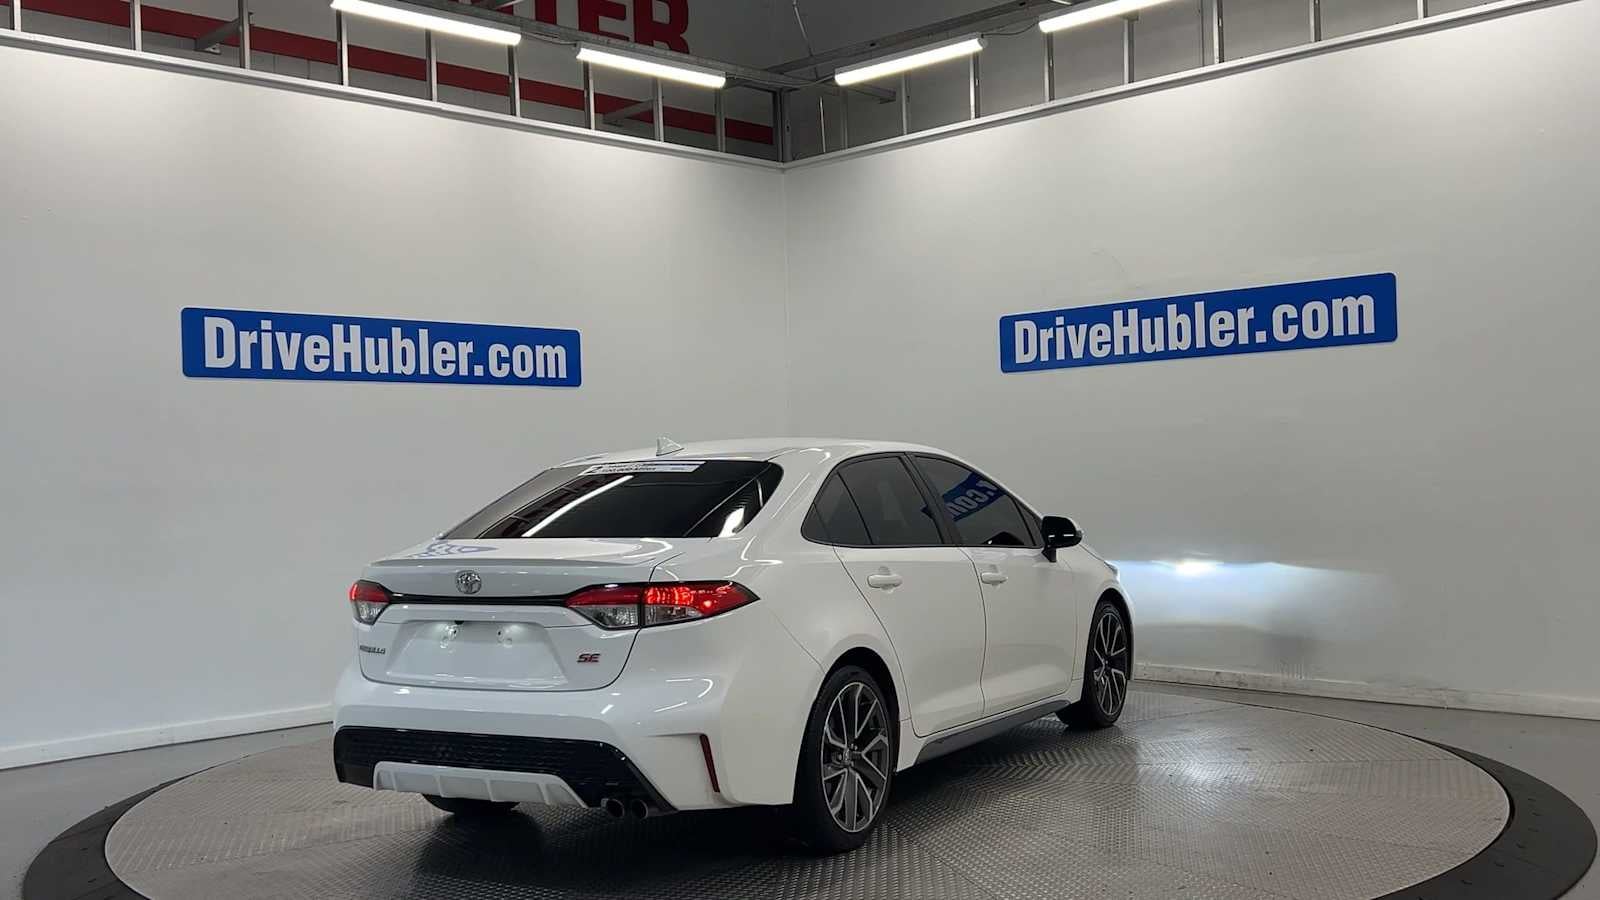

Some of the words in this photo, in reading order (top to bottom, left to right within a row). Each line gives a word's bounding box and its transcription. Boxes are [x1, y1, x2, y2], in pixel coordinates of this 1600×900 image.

[203, 315, 568, 379] DriveHubler.com
[1014, 293, 1376, 364] DriveHubler.com
[577, 653, 600, 663] SE
